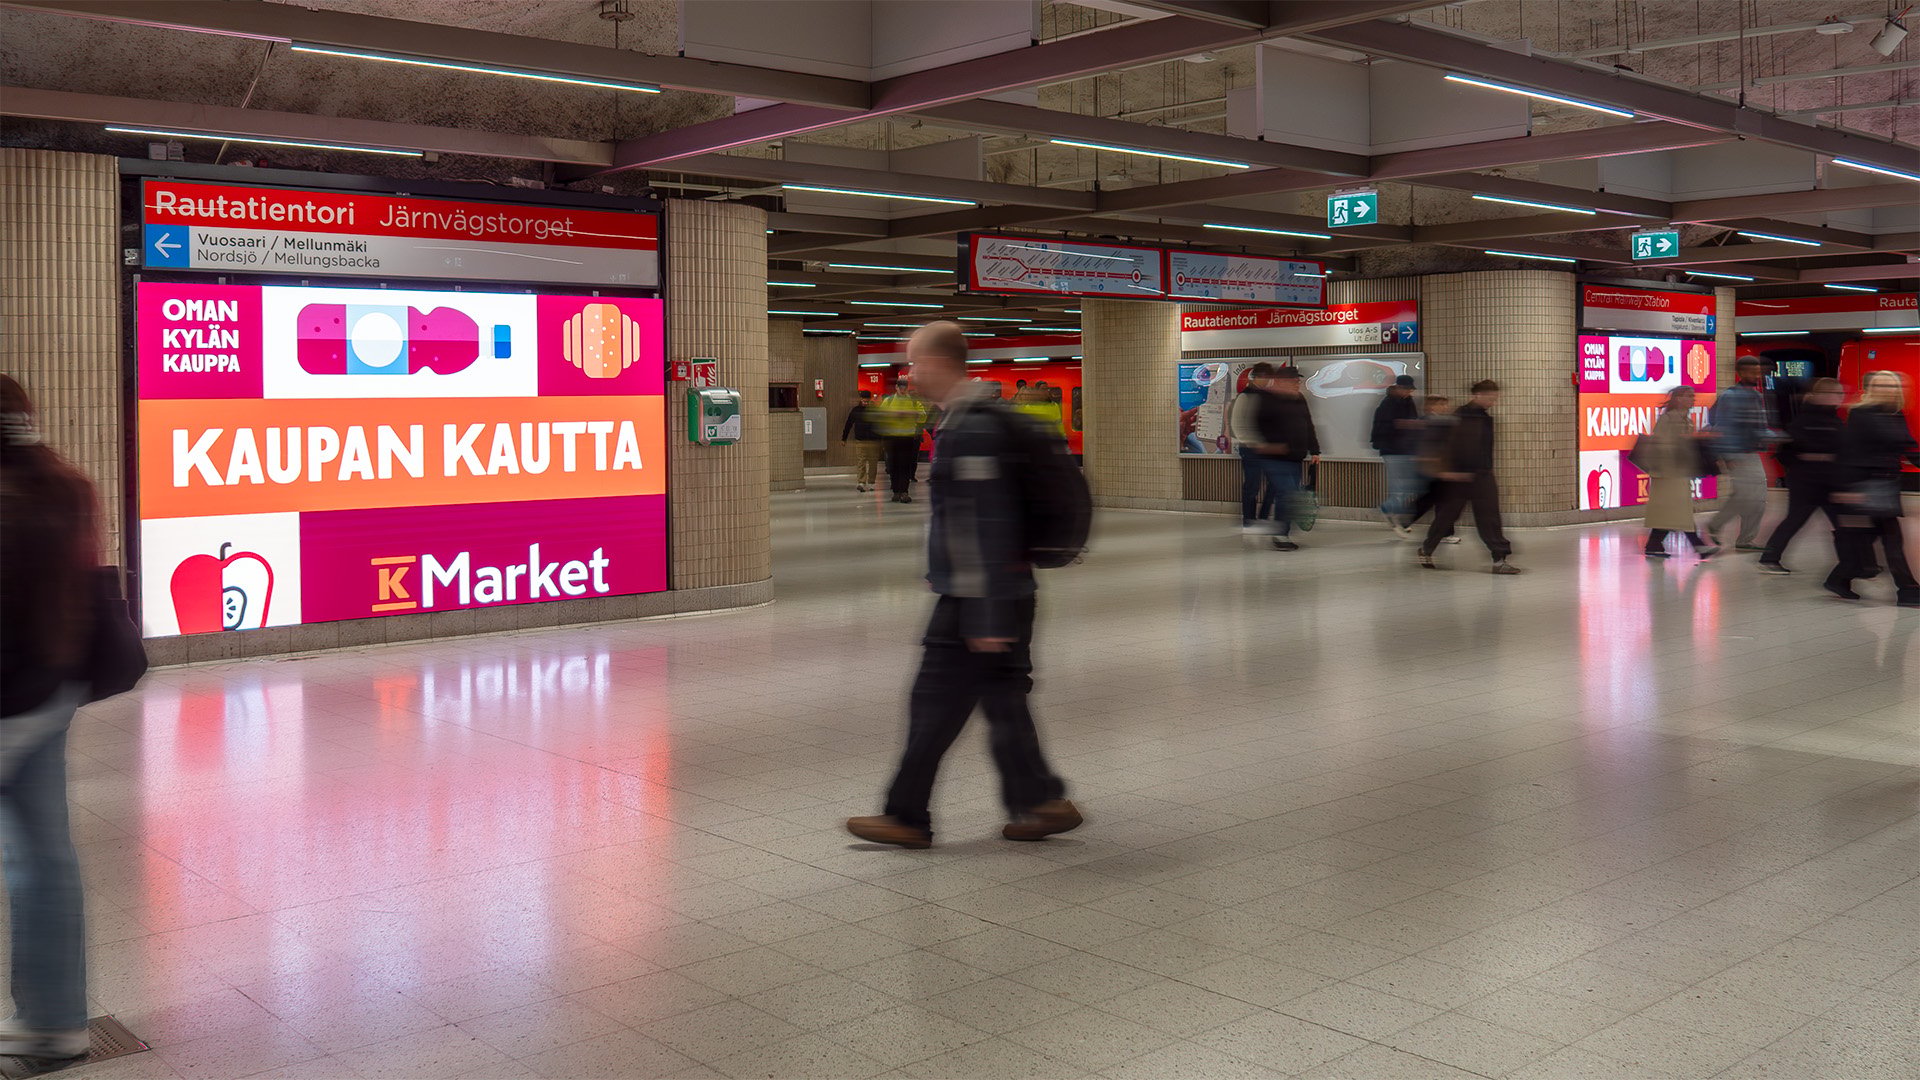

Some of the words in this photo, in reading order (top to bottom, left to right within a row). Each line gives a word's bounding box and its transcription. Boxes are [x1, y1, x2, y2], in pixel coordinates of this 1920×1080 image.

[156, 190, 355, 225] Rautatientori
[380, 204, 574, 240] Järnvägstorget
[198, 233, 266, 248] Vuosaari
[270, 235, 279, 250] /
[284, 237, 368, 253] Mellunmäki
[197, 249, 257, 264] Nordsjö
[262, 250, 270, 265] /
[274, 252, 380, 269] Mellungsbacka
[1585, 290, 1613, 304] Central
[1615, 293, 1643, 308] Railway
[1644, 294, 1670, 308] Station
[162, 298, 238, 322] OMAN
[1184, 313, 1258, 329] Rautatientori
[1267, 308, 1358, 325] Järnvägstorget
[162, 323, 240, 349] KYLÄN
[1584, 343, 1605, 355] OMAN
[162, 353, 241, 373] KAUPPA
[1233, 362, 1246, 376] Info
[1584, 355, 1605, 369] KYLÄN
[1586, 407, 1651, 437] KAUPAN
[171, 424, 425, 488] KAUPAN
[443, 420, 643, 478] KAUTTA
[421, 543, 610, 608] Market
